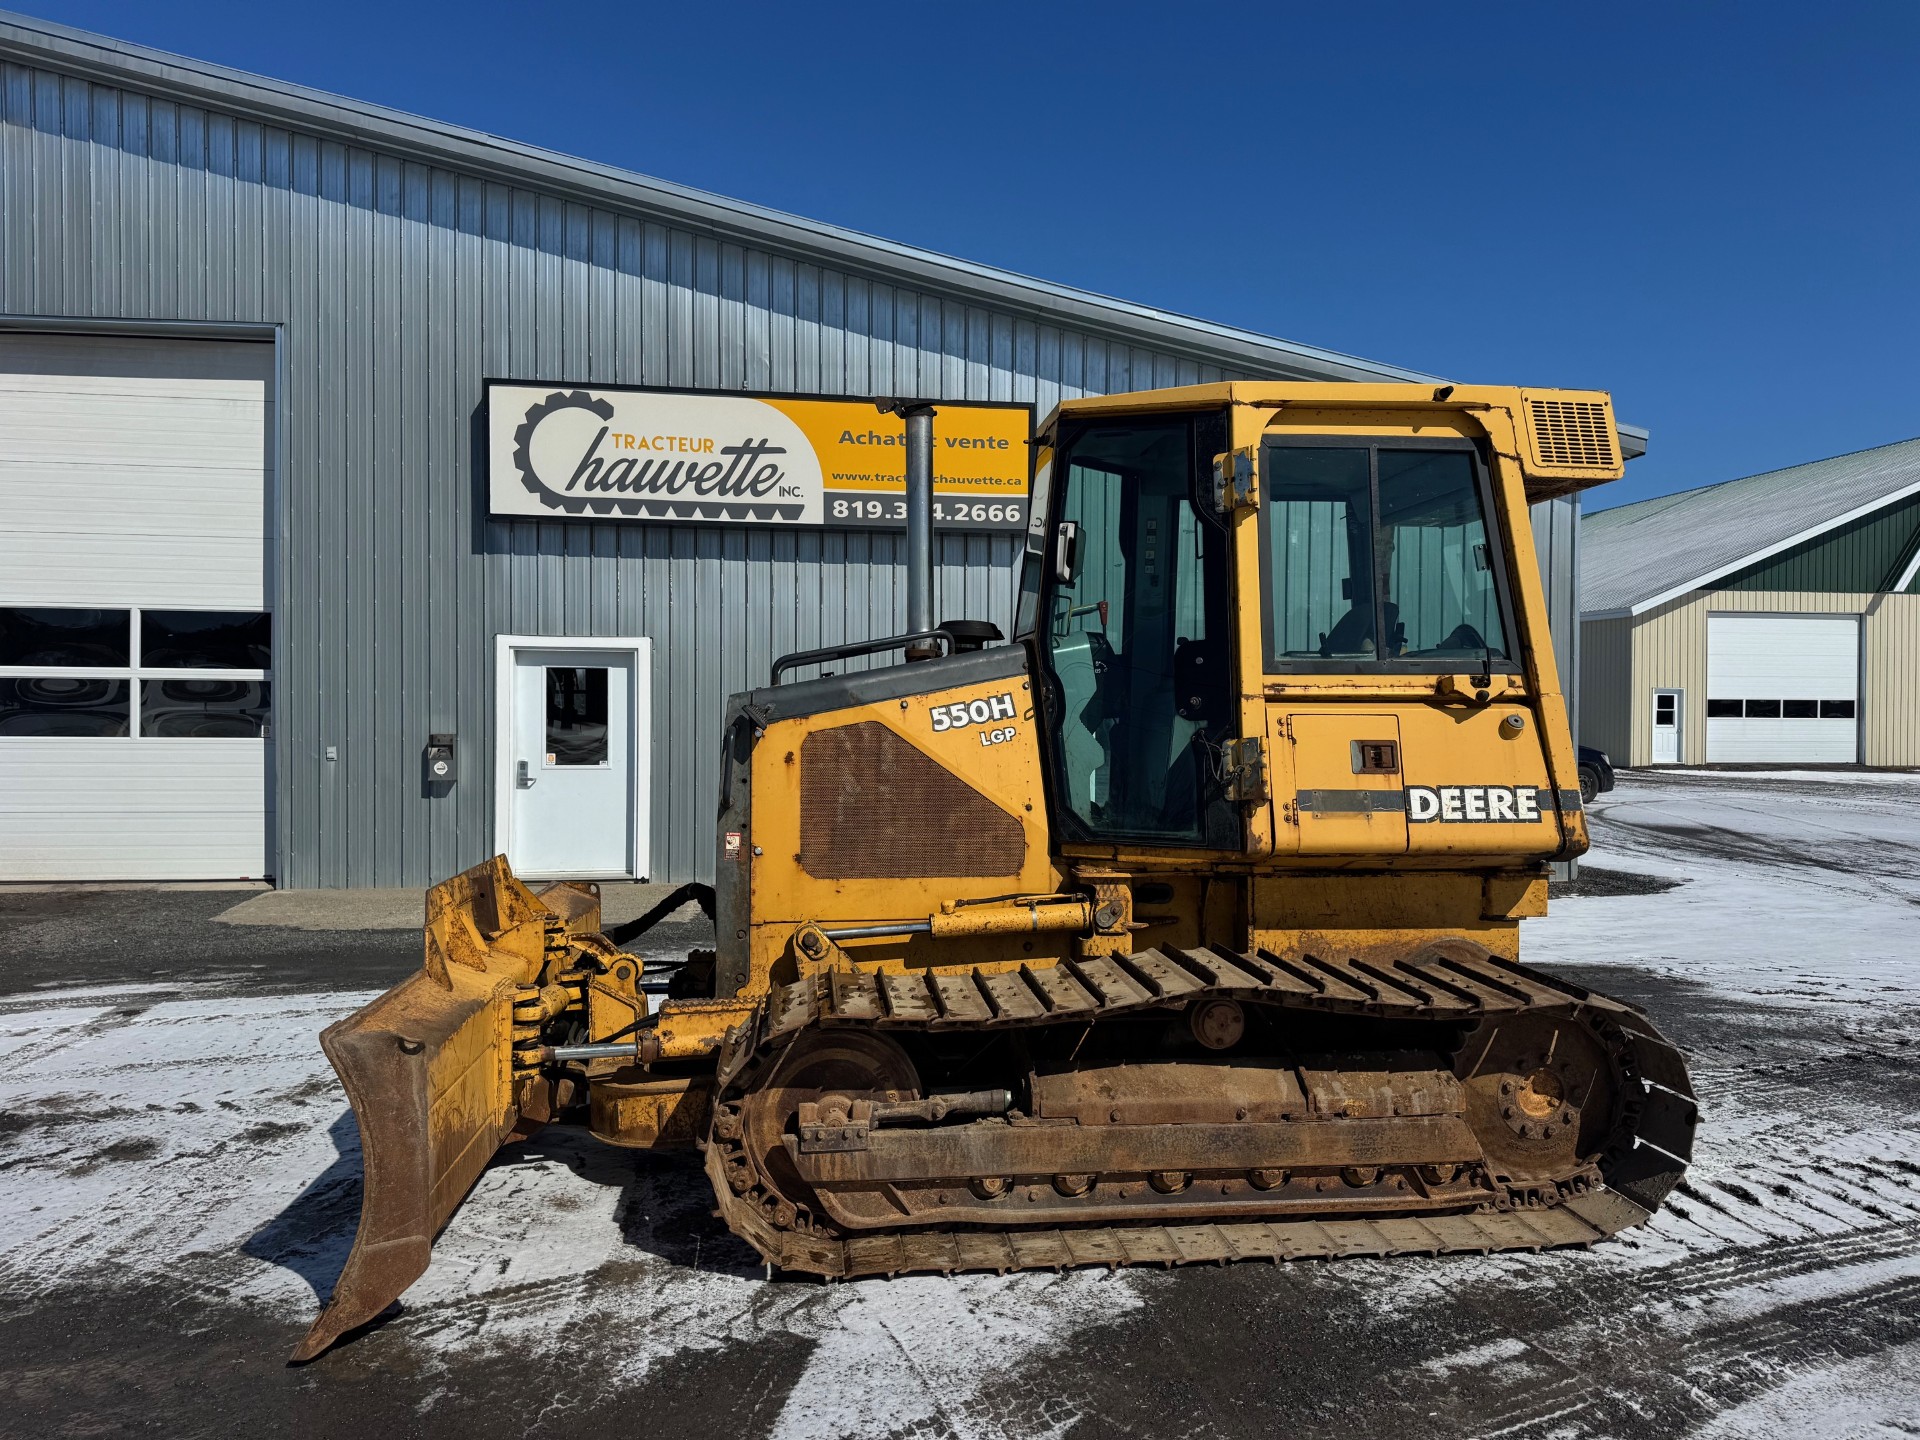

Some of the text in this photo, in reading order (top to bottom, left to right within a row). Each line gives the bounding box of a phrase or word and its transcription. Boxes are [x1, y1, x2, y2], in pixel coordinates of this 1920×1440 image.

[513, 390, 804, 510] Chauvette INC.
[611, 433, 715, 454] TRACTEUR
[838, 430, 907, 447] Achat
[945, 435, 1009, 450] vente
[832, 472, 1022, 486] www.tractchauvette.ca
[832, 500, 1021, 522] 819.34.2666
[930, 693, 1016, 731] 550H
[980, 727, 1016, 746] LGP
[1407, 786, 1540, 821] DEERE
